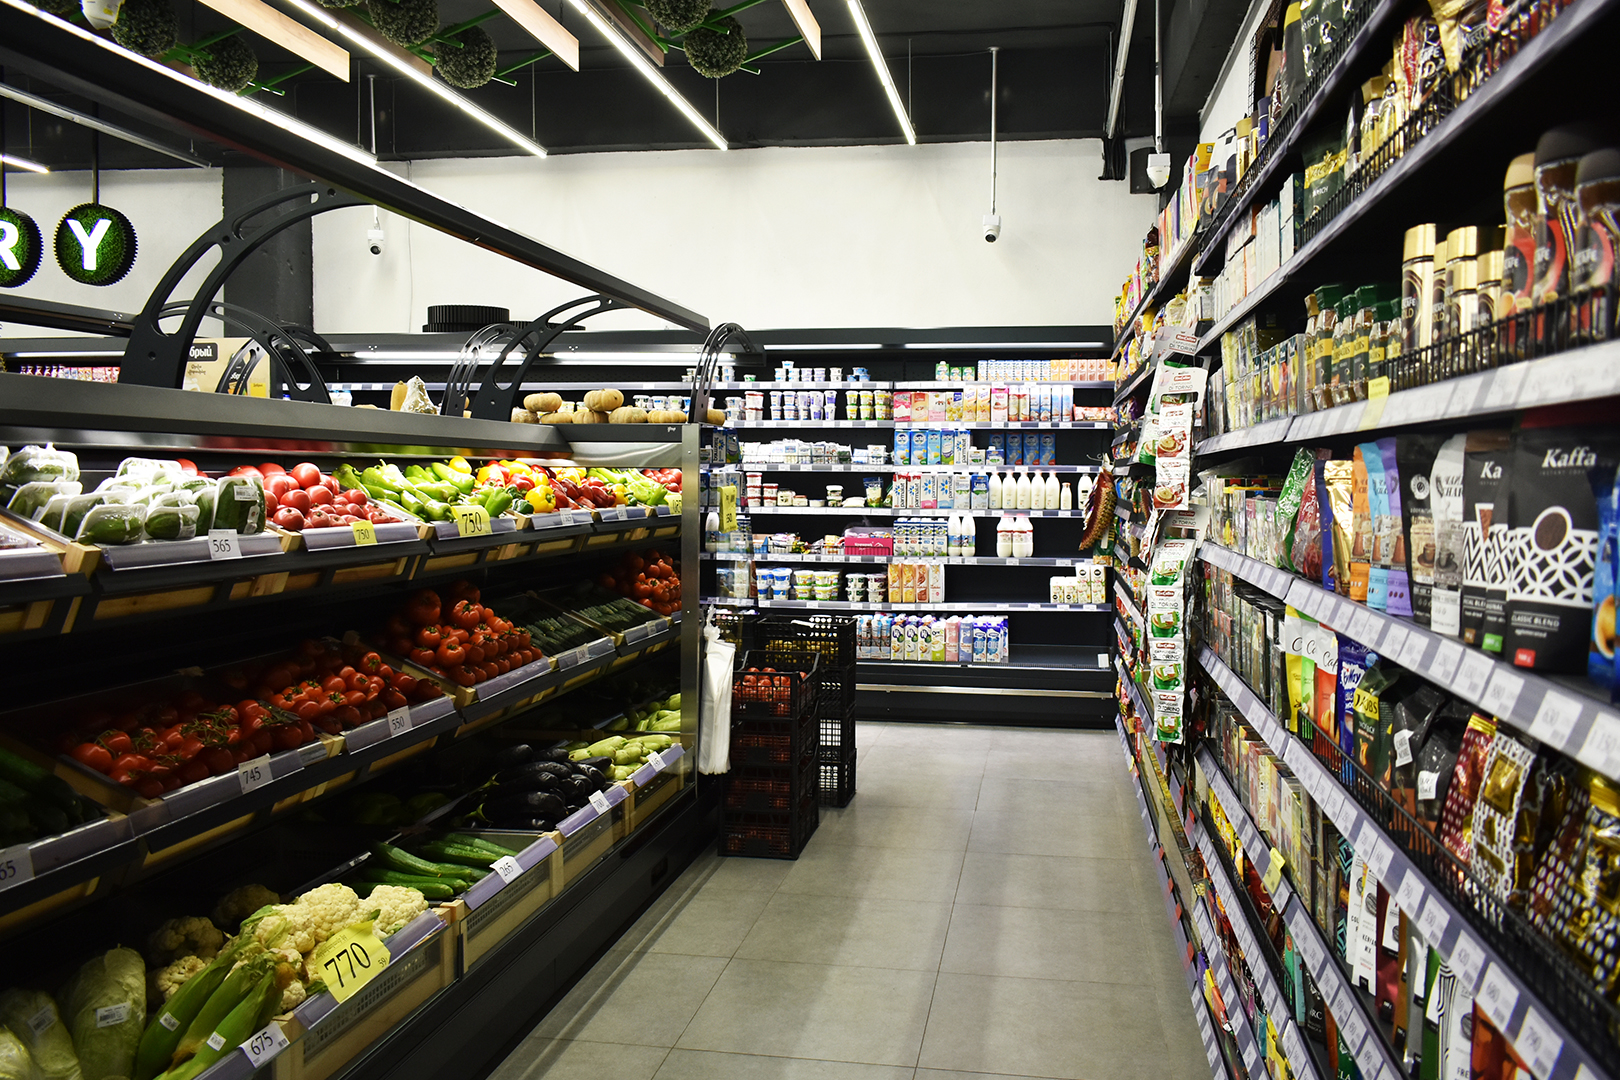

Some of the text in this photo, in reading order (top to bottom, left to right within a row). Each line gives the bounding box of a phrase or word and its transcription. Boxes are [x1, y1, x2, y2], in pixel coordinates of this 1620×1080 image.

[1541, 446, 1597, 468] Kaffa
[462, 512, 482, 534] 750
[356, 529, 370, 541] 750
[213, 539, 231, 552] 565
[1534, 616, 1560, 628] BLEND
[391, 716, 405, 731] 550
[243, 766, 262, 785] 745
[500, 862, 513, 877] 265
[324, 943, 371, 988] 770
[250, 1031, 274, 1056] 675
